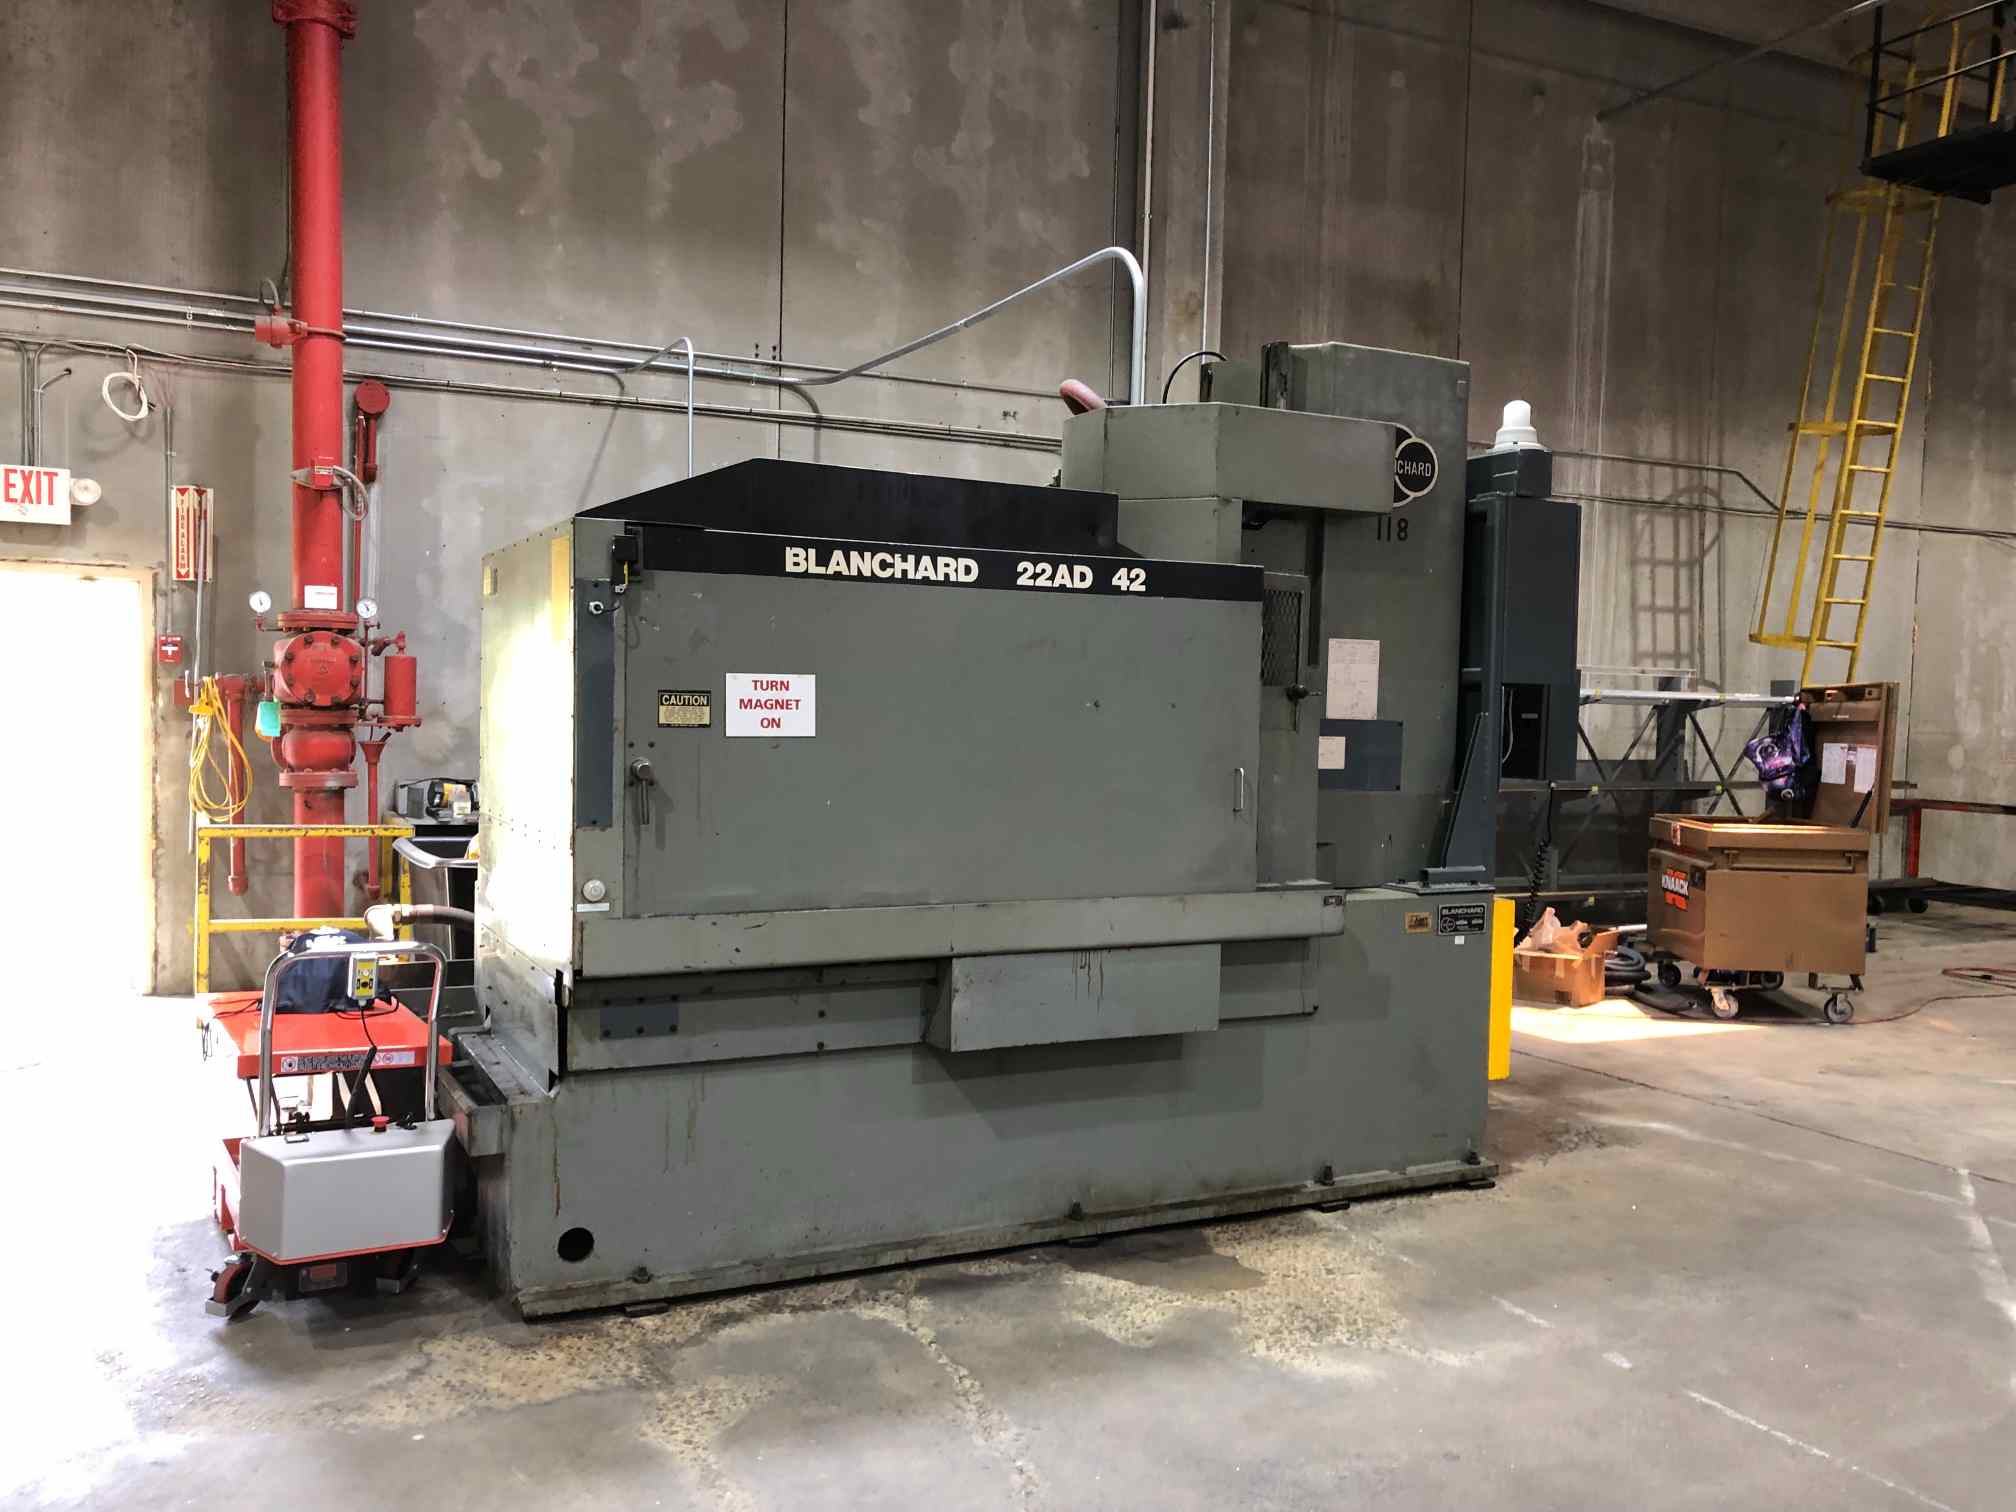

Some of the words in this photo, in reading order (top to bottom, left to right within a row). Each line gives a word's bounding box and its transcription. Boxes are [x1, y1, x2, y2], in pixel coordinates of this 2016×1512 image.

[4, 468, 59, 506] EXIT
[785, 546, 979, 583] BLANCHARD
[1016, 561, 1094, 589] 22AD
[1111, 567, 1147, 592] 42
[752, 679, 790, 692] TURN
[662, 694, 708, 706] CAUTION
[739, 698, 802, 711] MAGNET
[760, 717, 781, 729] ON
